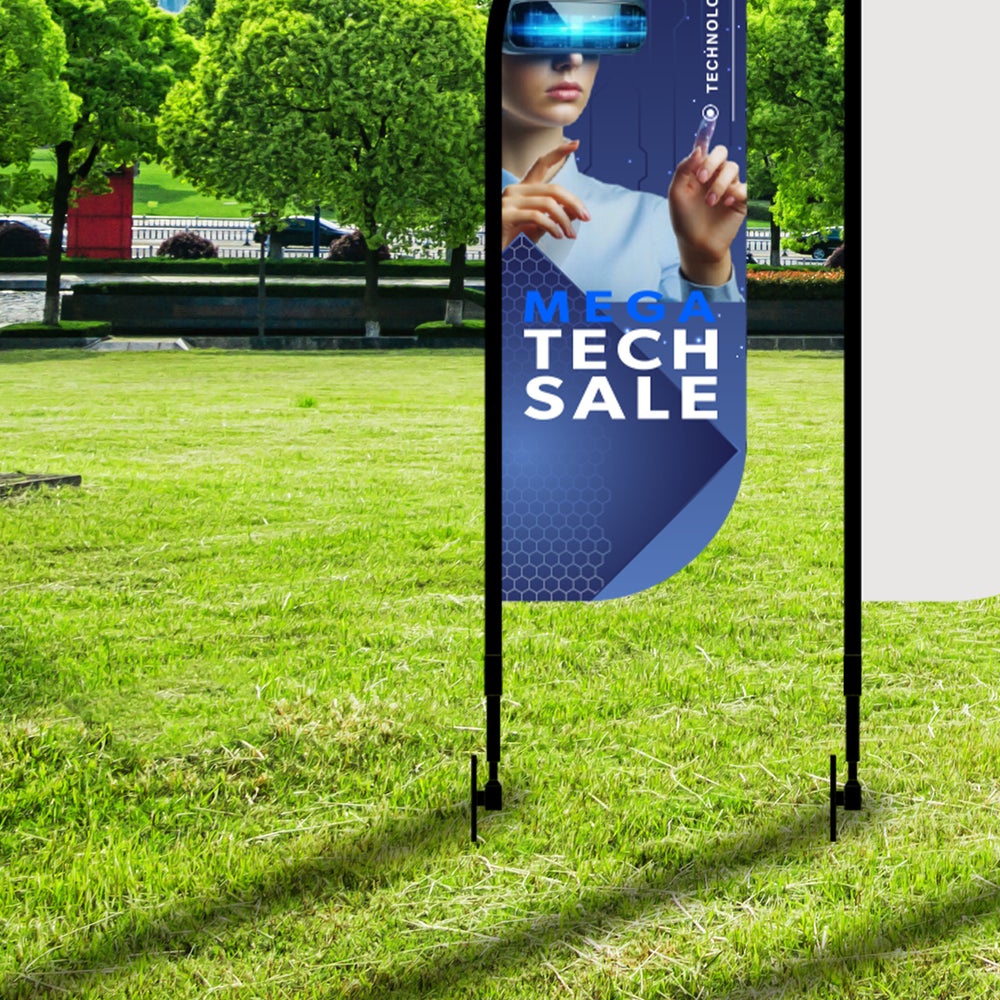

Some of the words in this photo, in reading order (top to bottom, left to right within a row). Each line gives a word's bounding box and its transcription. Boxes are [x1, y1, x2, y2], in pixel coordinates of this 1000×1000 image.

[523, 290, 716, 323] MEGA
[523, 329, 718, 370] TECH
[523, 376, 718, 420] SALE
